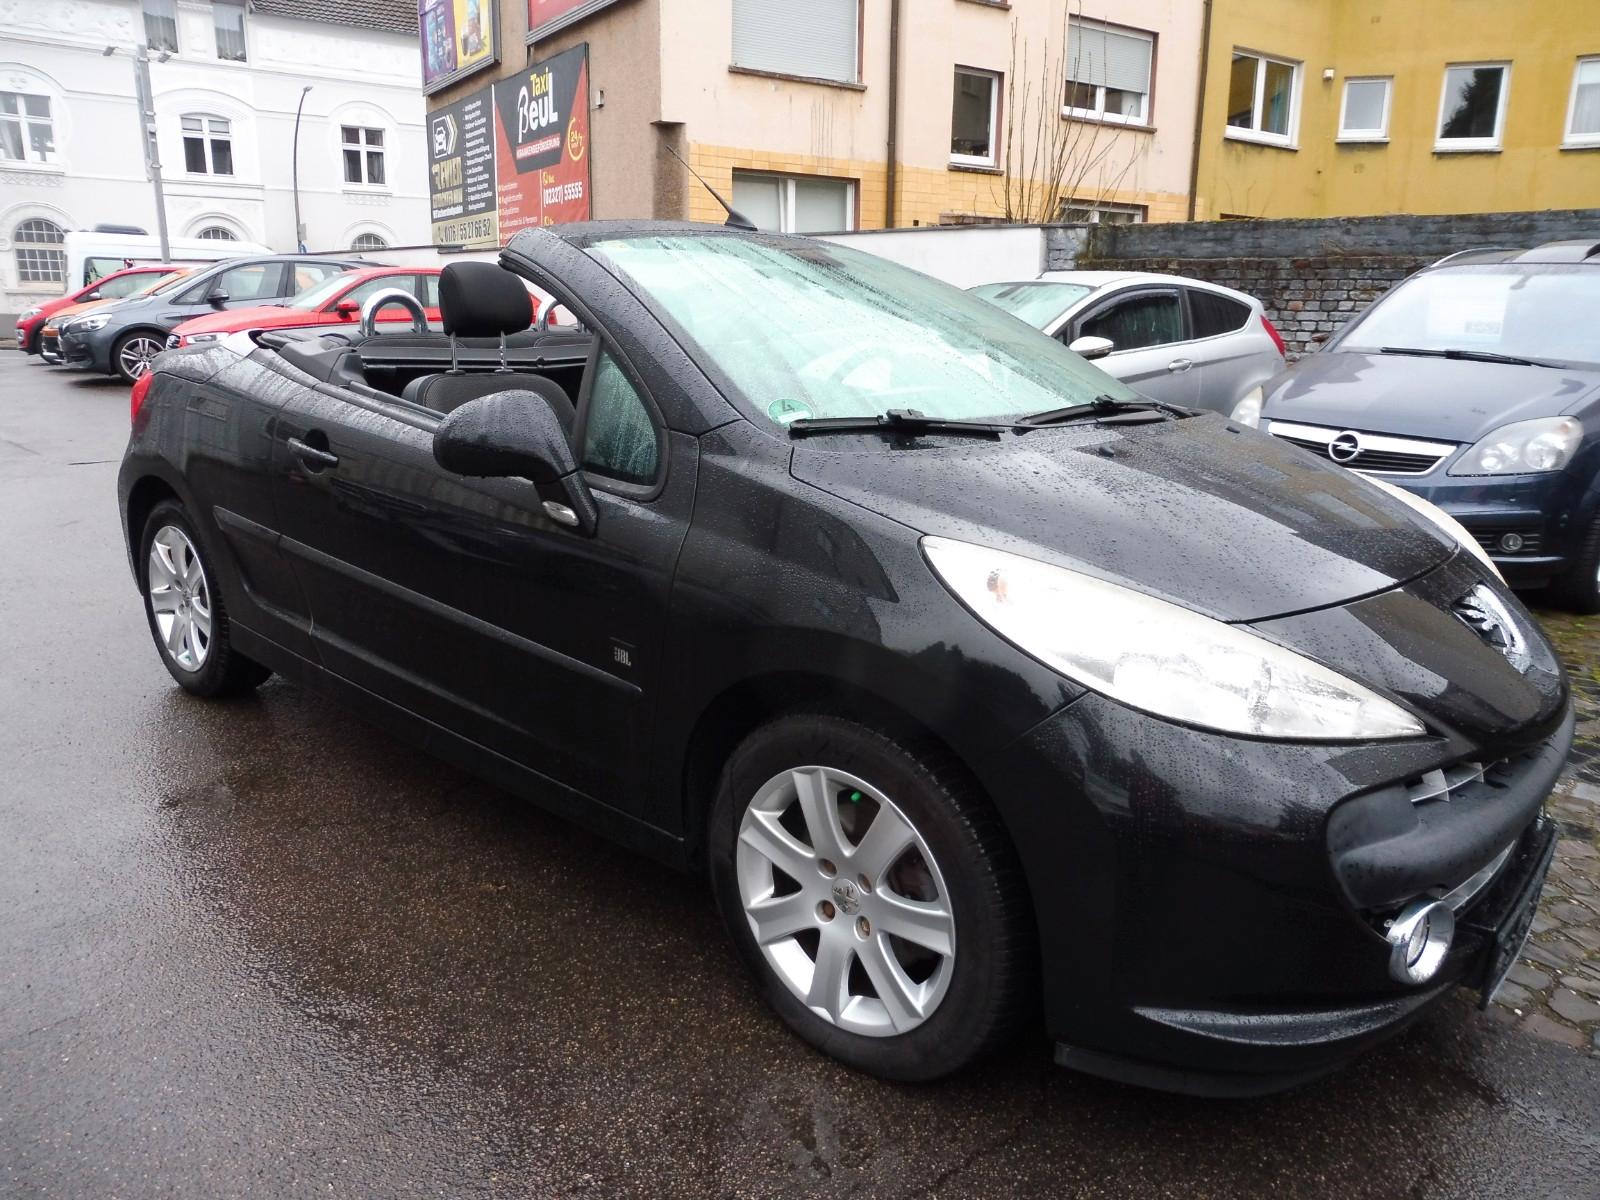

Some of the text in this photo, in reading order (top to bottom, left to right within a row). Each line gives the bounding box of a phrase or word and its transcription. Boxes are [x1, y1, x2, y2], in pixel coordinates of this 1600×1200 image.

[530, 67, 549, 97] Taxi
[543, 185, 564, 208] (02327)
[564, 181, 583, 201] 55555
[444, 224, 457, 243] 0176
[613, 646, 632, 667] JBL
